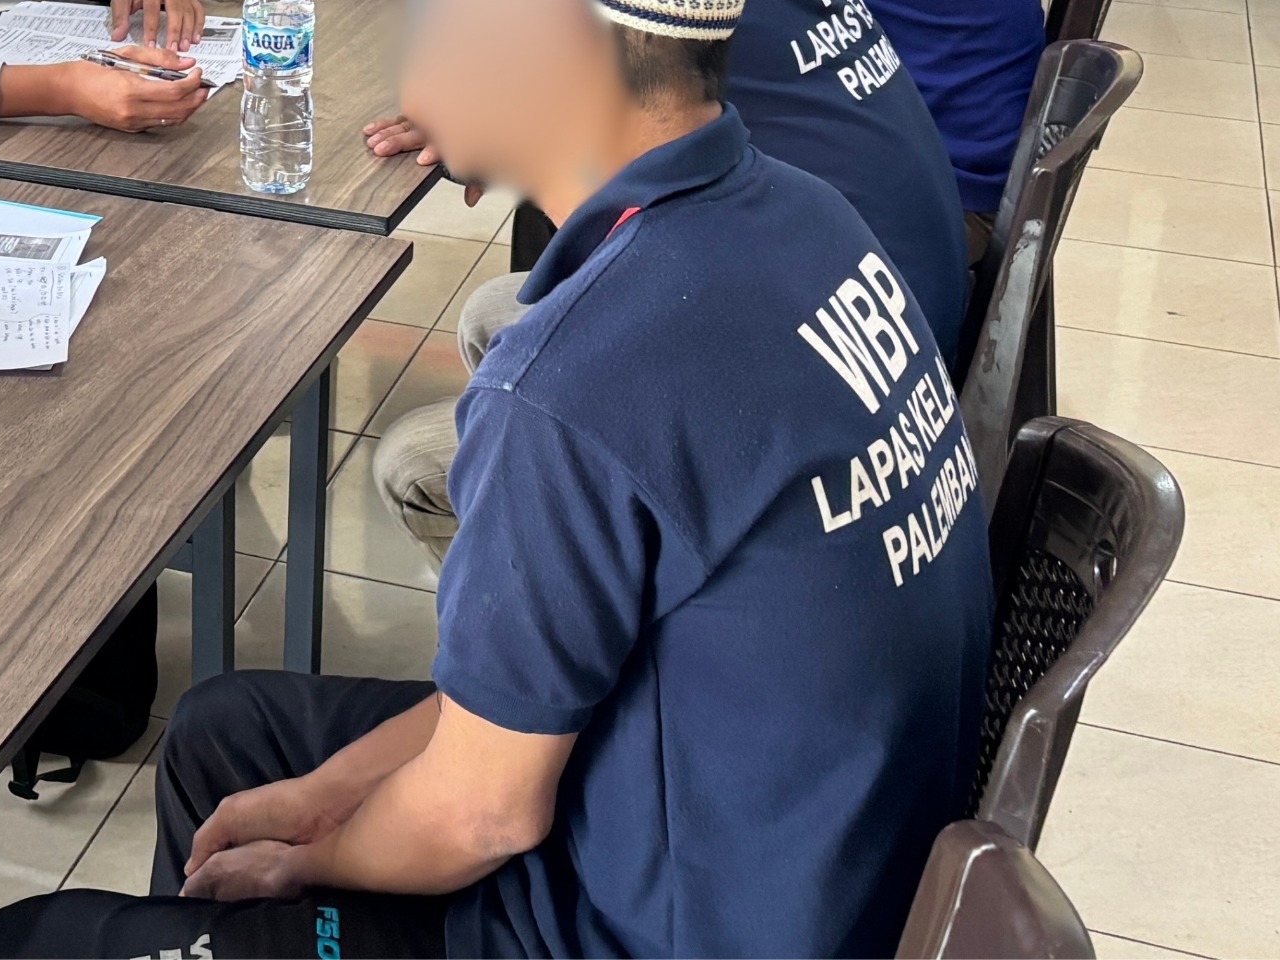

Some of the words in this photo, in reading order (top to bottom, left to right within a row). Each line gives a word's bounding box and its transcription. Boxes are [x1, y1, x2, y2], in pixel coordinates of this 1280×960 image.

[251, 31, 296, 53] AQUA
[790, 4, 862, 75] LAPAS
[797, 252, 920, 414] WBP
[811, 412, 925, 534] LAPAS
[906, 355, 956, 452] KELA
[882, 434, 979, 588] PALEMBAN
